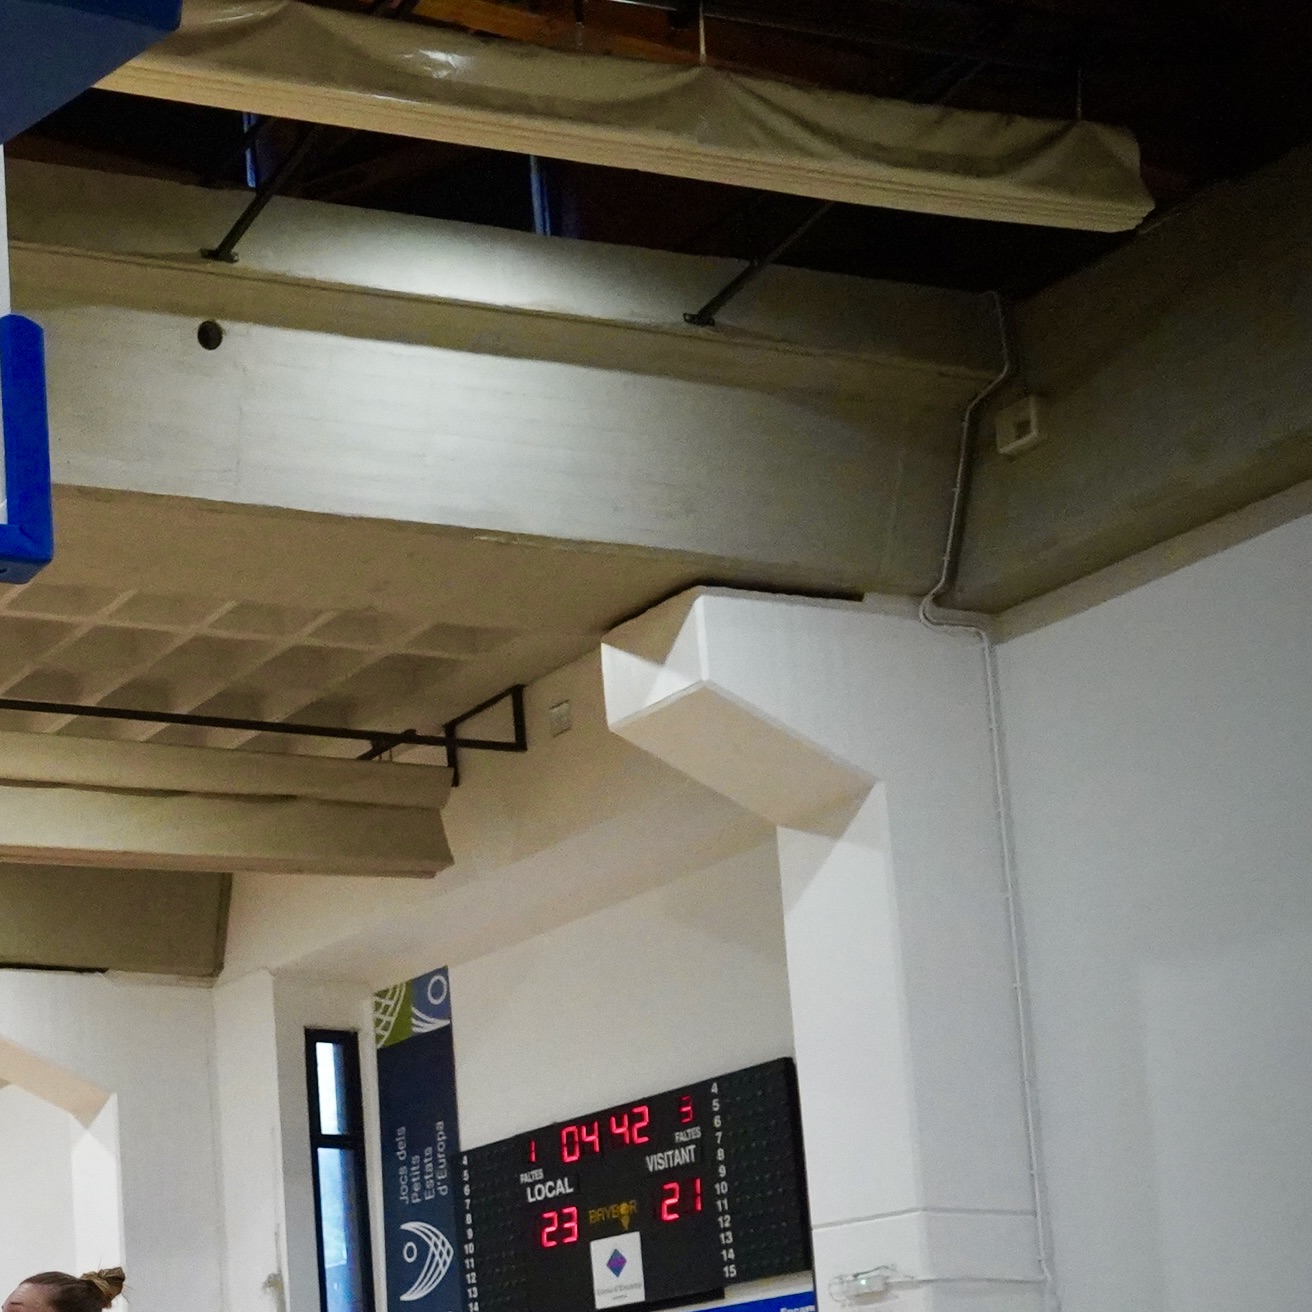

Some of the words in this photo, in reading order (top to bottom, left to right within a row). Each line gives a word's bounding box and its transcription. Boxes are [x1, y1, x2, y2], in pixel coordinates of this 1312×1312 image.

[711, 1082, 719, 1095] 4
[712, 1099, 720, 1111] 5
[713, 1115, 722, 1128] 6
[675, 1126, 702, 1143] FALTES
[715, 1132, 723, 1144] 7
[462, 1155, 468, 1166] 4
[645, 1144, 696, 1173] VISITANT
[717, 1148, 725, 1161] 8
[519, 1168, 544, 1184] FALTES
[718, 1165, 727, 1178] 9
[527, 1177, 574, 1203] LOCAL
[714, 1182, 728, 1195] 10
[661, 1178, 702, 1221] 21
[716, 1199, 729, 1212] 11
[541, 1206, 579, 1248] 23
[717, 1215, 732, 1229] 12
[720, 1232, 733, 1245] 13
[721, 1248, 735, 1262] 14
[723, 1265, 737, 1279] 15
